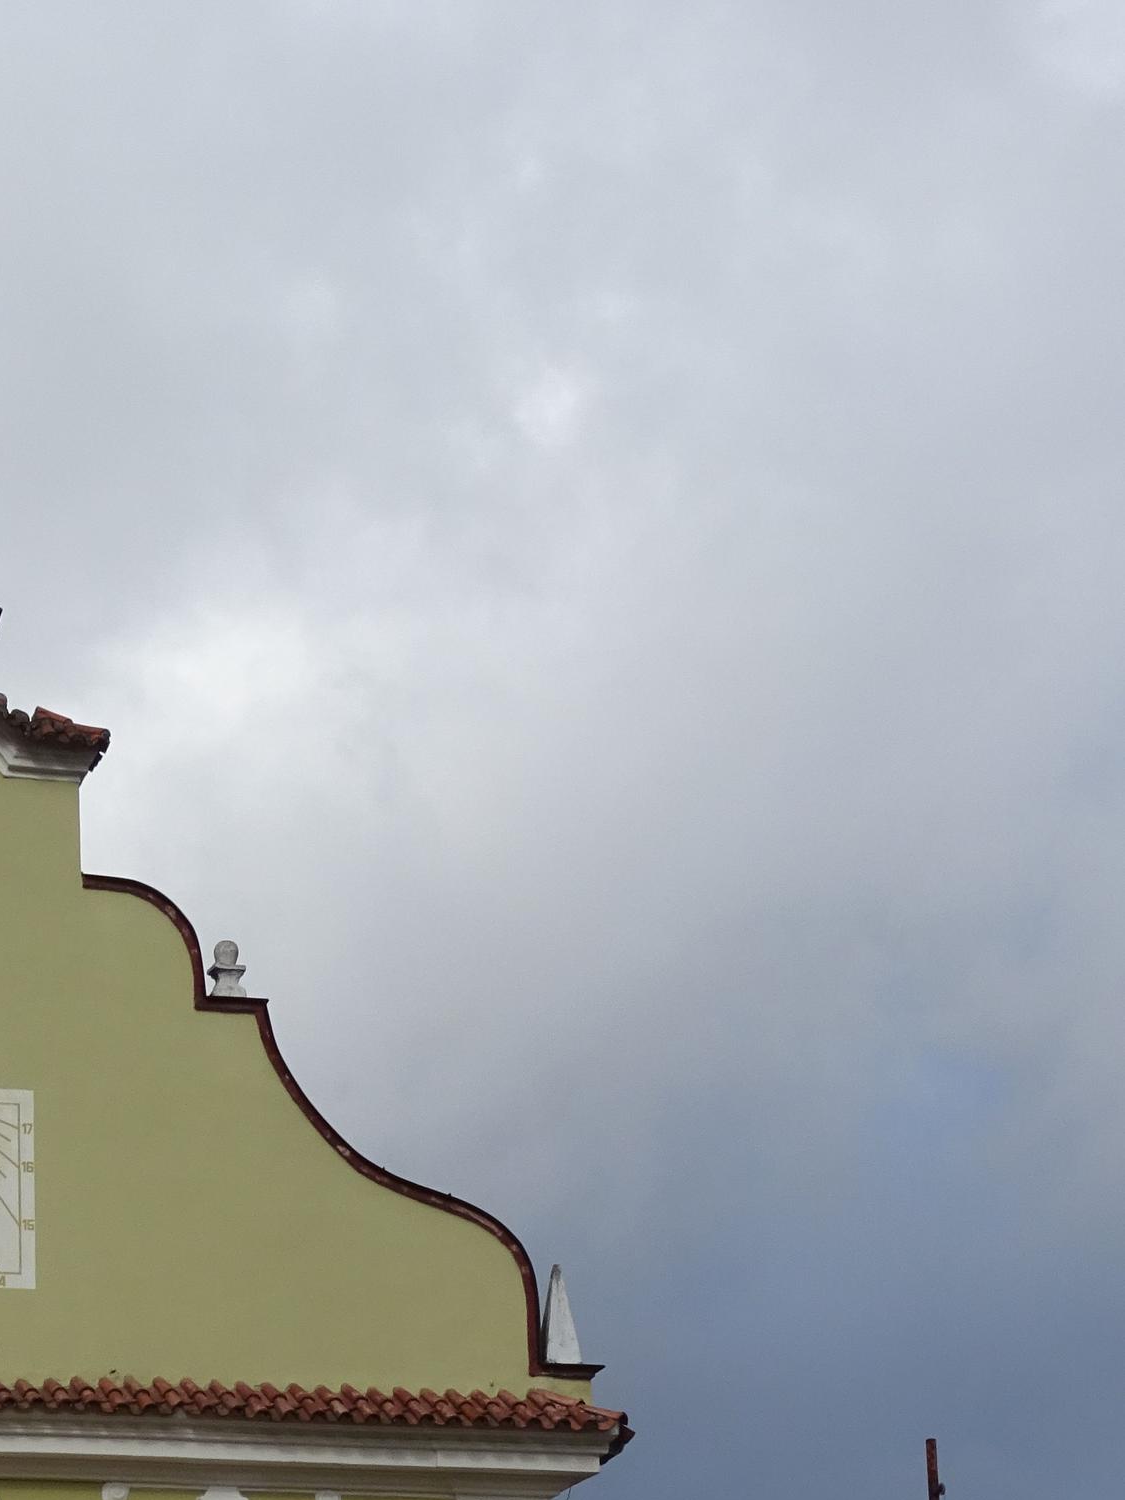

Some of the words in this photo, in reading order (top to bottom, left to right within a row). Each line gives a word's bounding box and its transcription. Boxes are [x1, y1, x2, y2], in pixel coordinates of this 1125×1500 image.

[22, 1123, 33, 1134] 17
[22, 1161, 34, 1173] 16
[22, 1219, 34, 1231] 15
